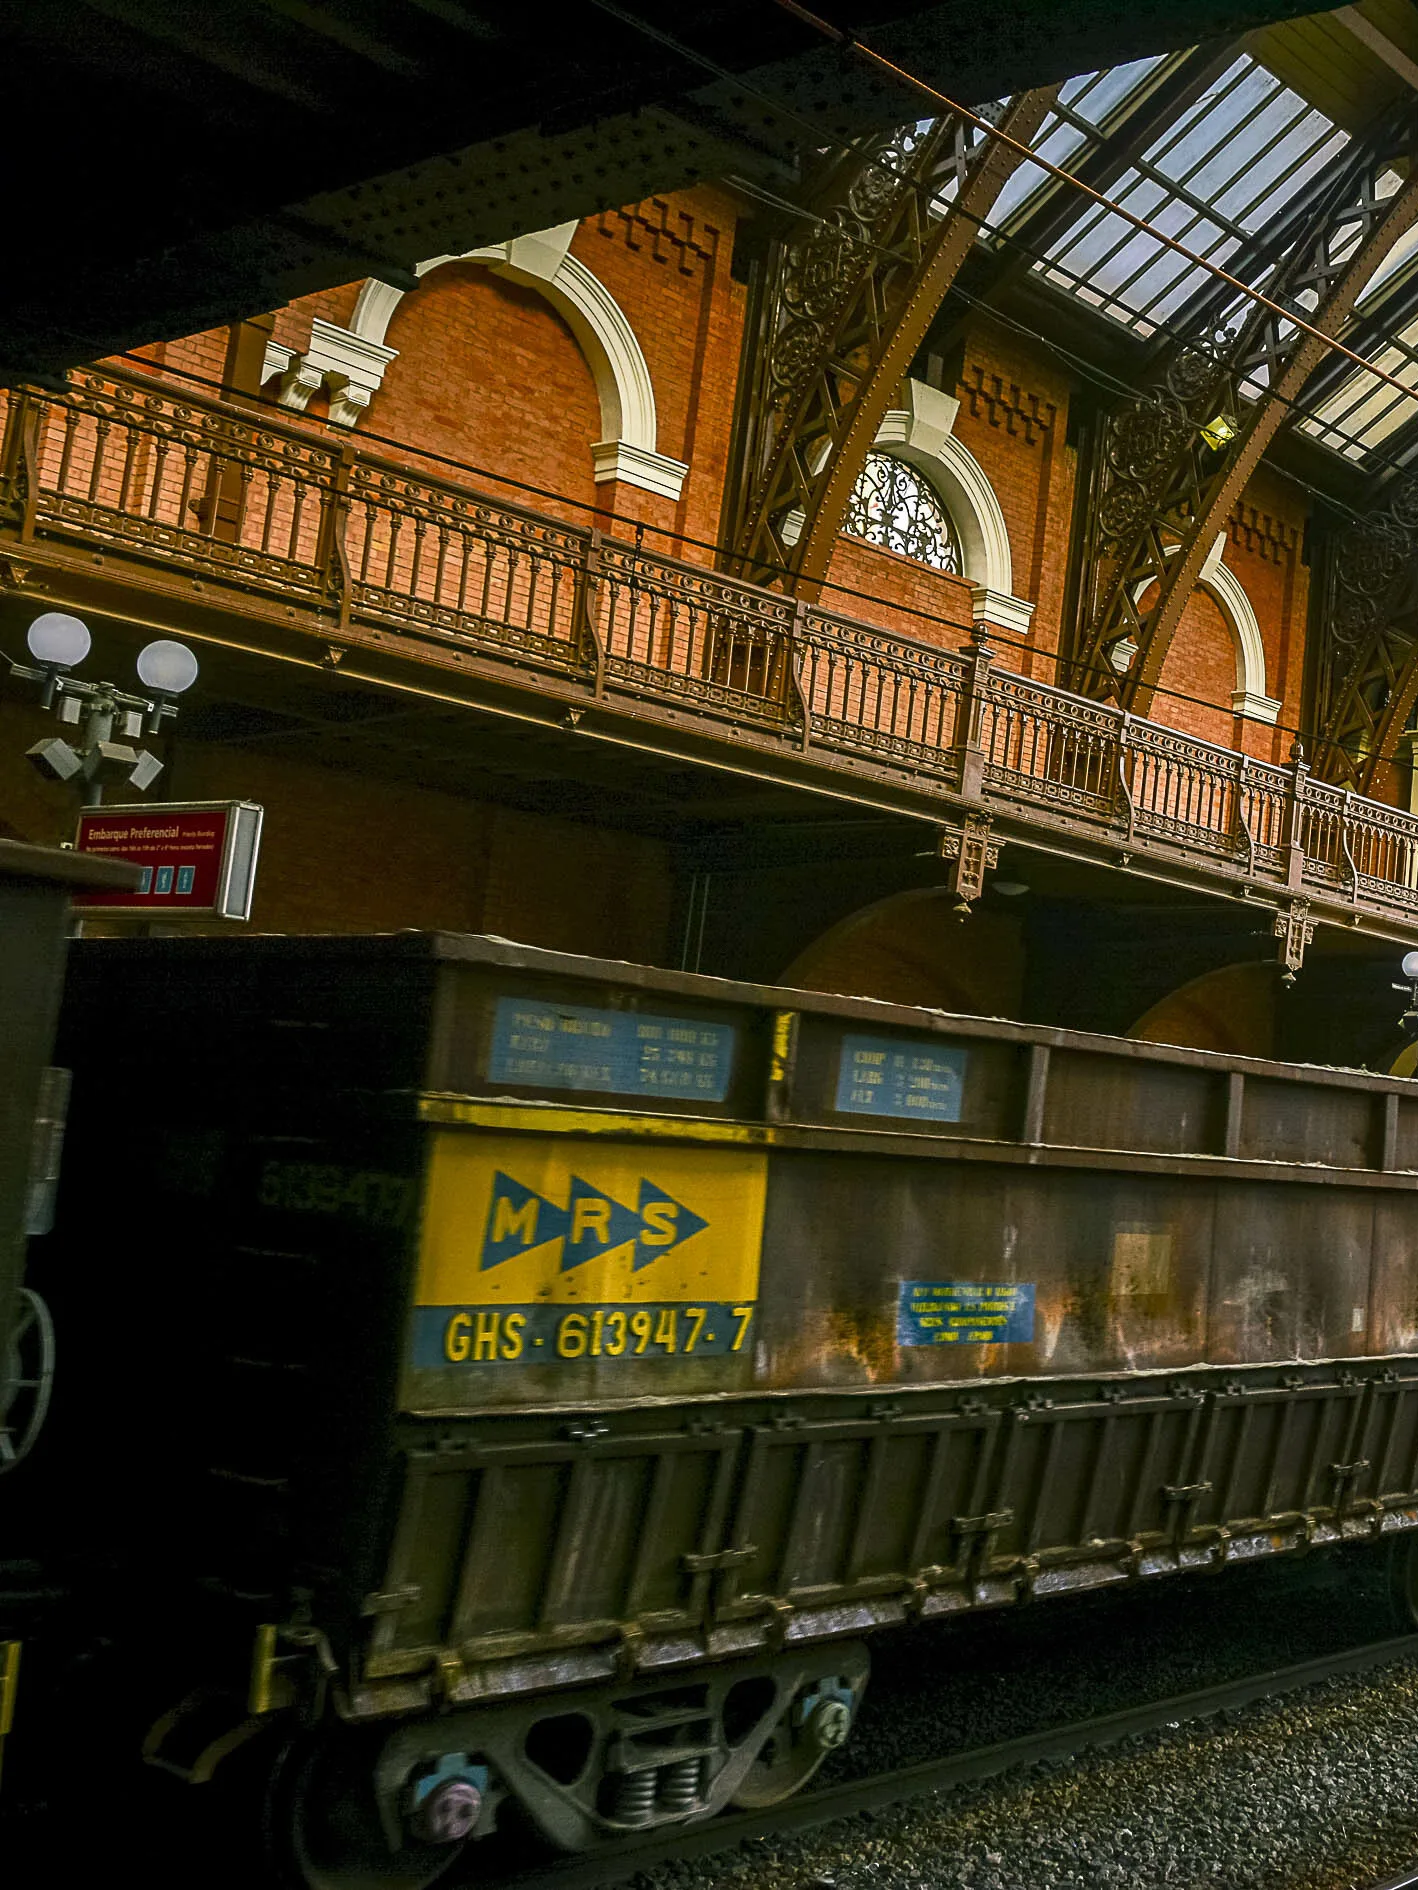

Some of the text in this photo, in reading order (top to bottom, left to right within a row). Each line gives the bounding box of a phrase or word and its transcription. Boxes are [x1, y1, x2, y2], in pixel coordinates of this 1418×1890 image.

[88, 828, 128, 841] Embarque
[130, 826, 179, 839] Preferencial
[491, 1197, 680, 1246] MRS
